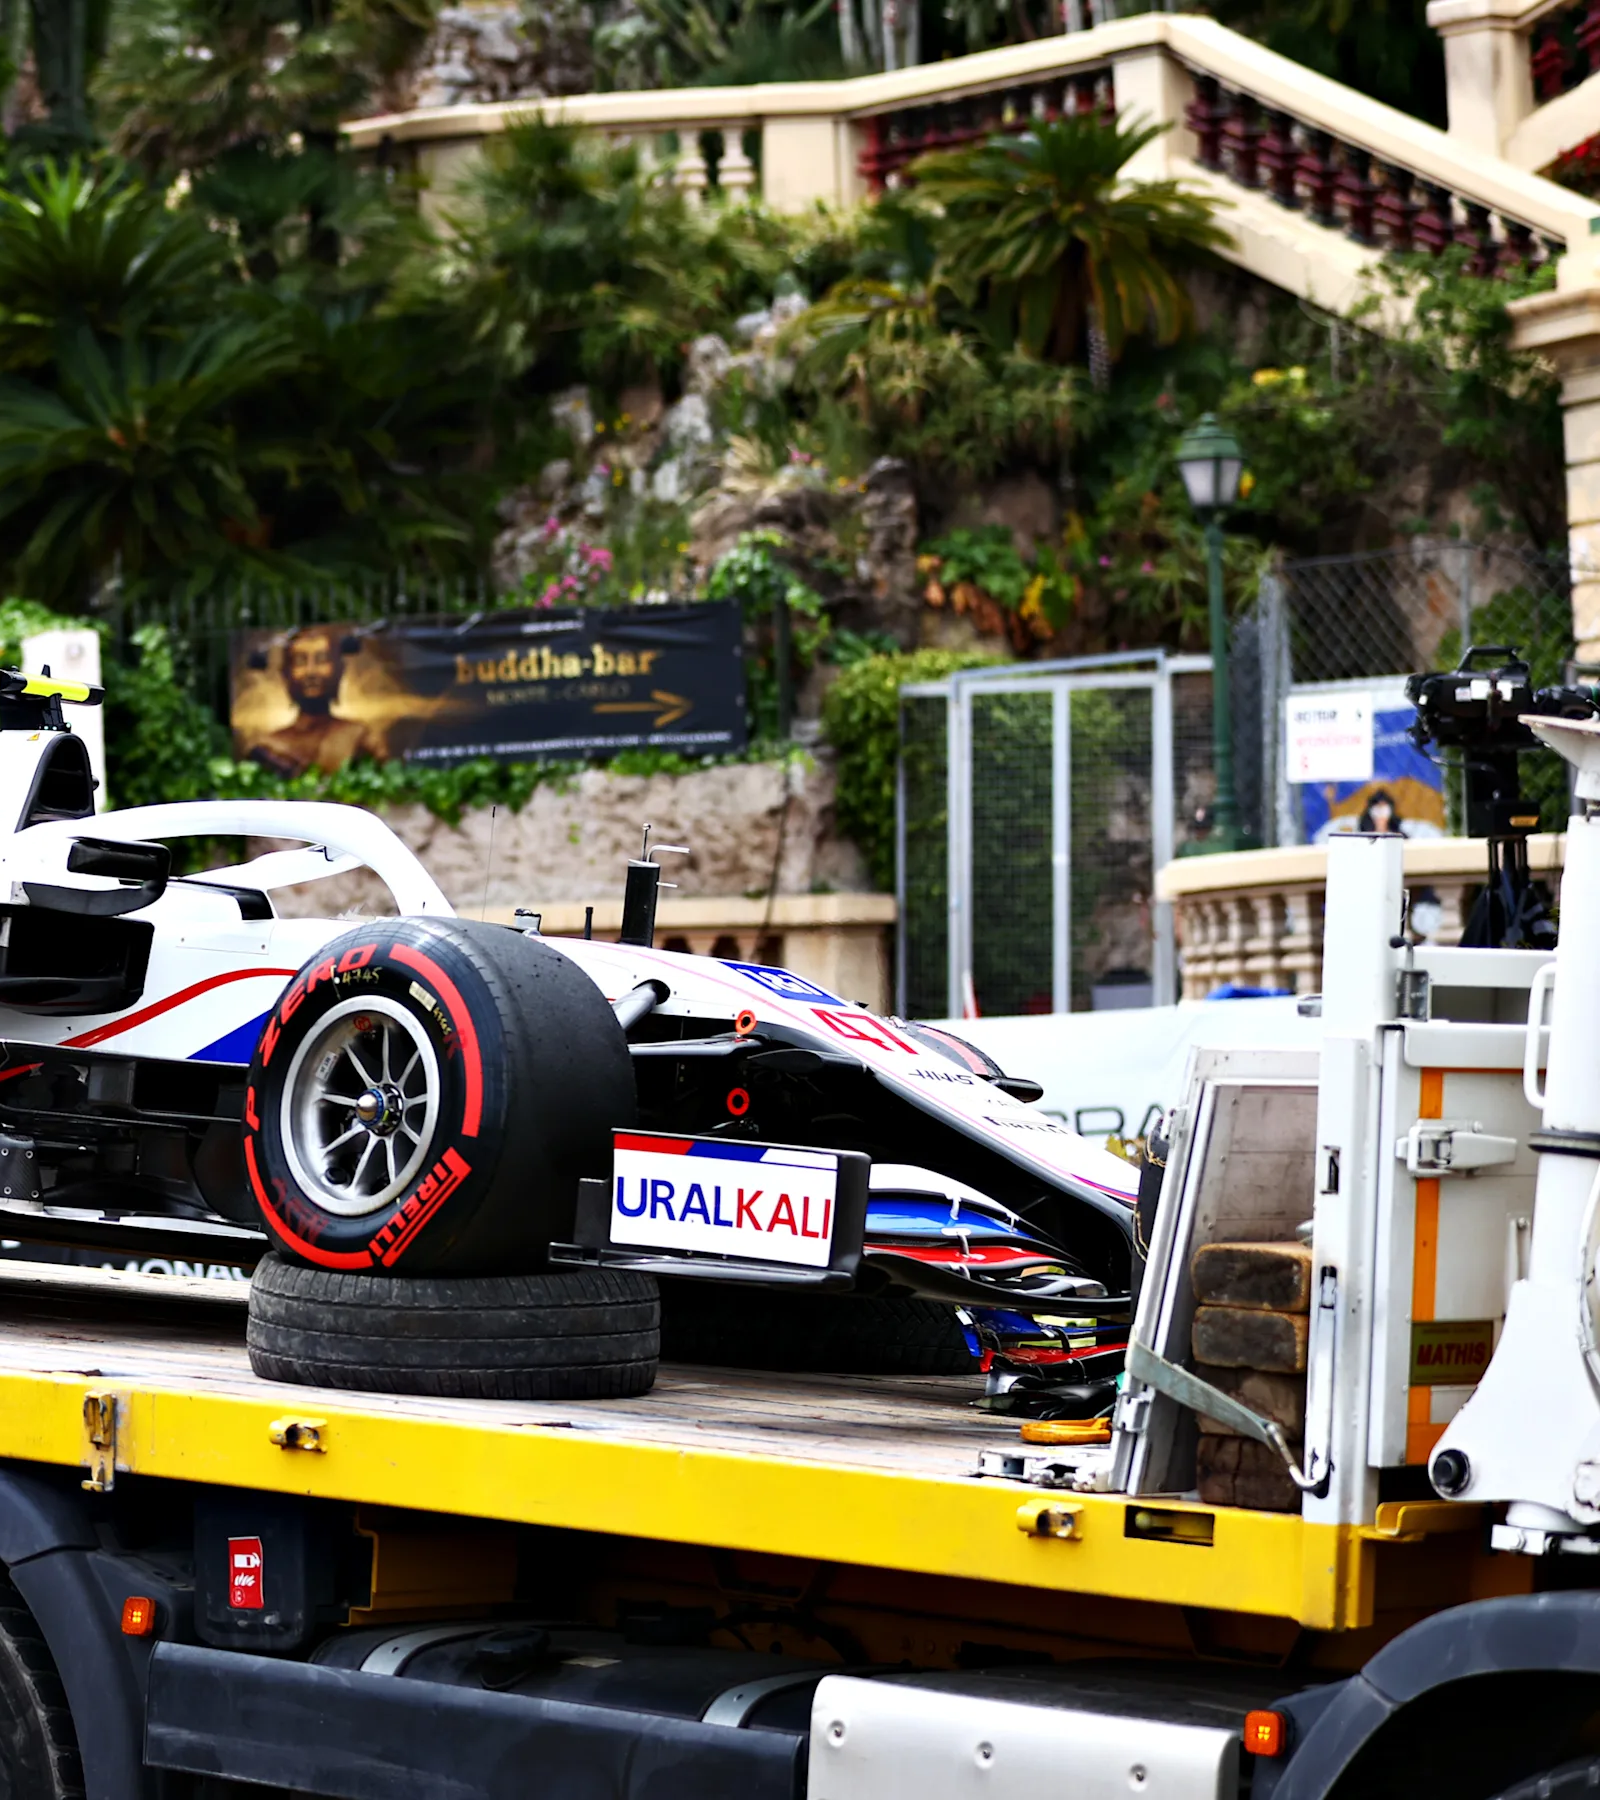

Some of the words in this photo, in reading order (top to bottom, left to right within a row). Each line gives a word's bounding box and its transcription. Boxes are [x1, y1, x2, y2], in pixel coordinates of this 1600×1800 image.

[456, 644, 657, 684] buddha-bar
[259, 943, 378, 1067] ZERO
[736, 968, 824, 997] 1&1
[809, 1008, 920, 1056] 47
[369, 1147, 473, 1268] PIRELLI
[616, 1176, 831, 1240] URALKALI
[1416, 1341, 1488, 1367] MATHIS
